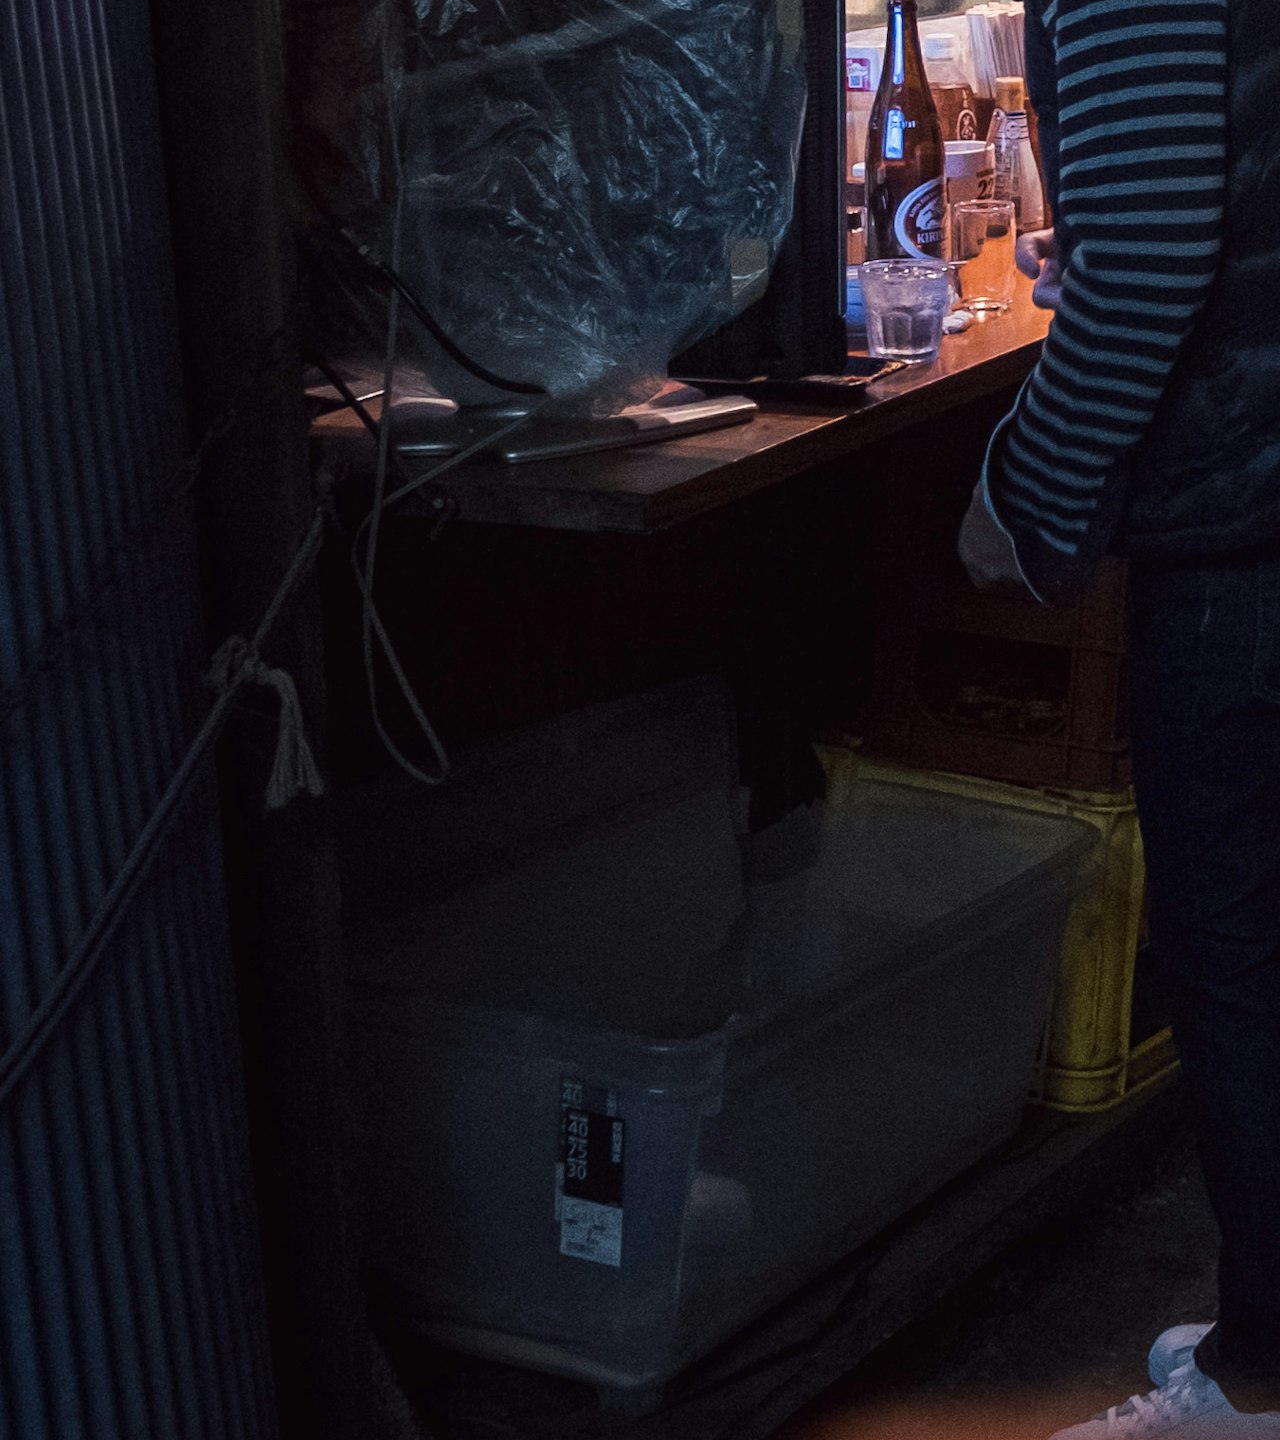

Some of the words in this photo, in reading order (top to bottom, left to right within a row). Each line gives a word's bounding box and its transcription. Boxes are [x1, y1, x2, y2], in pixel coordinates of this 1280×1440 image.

[568, 1121, 588, 1137] 40
[568, 1142, 587, 1159] 75
[567, 1164, 587, 1180] 30
